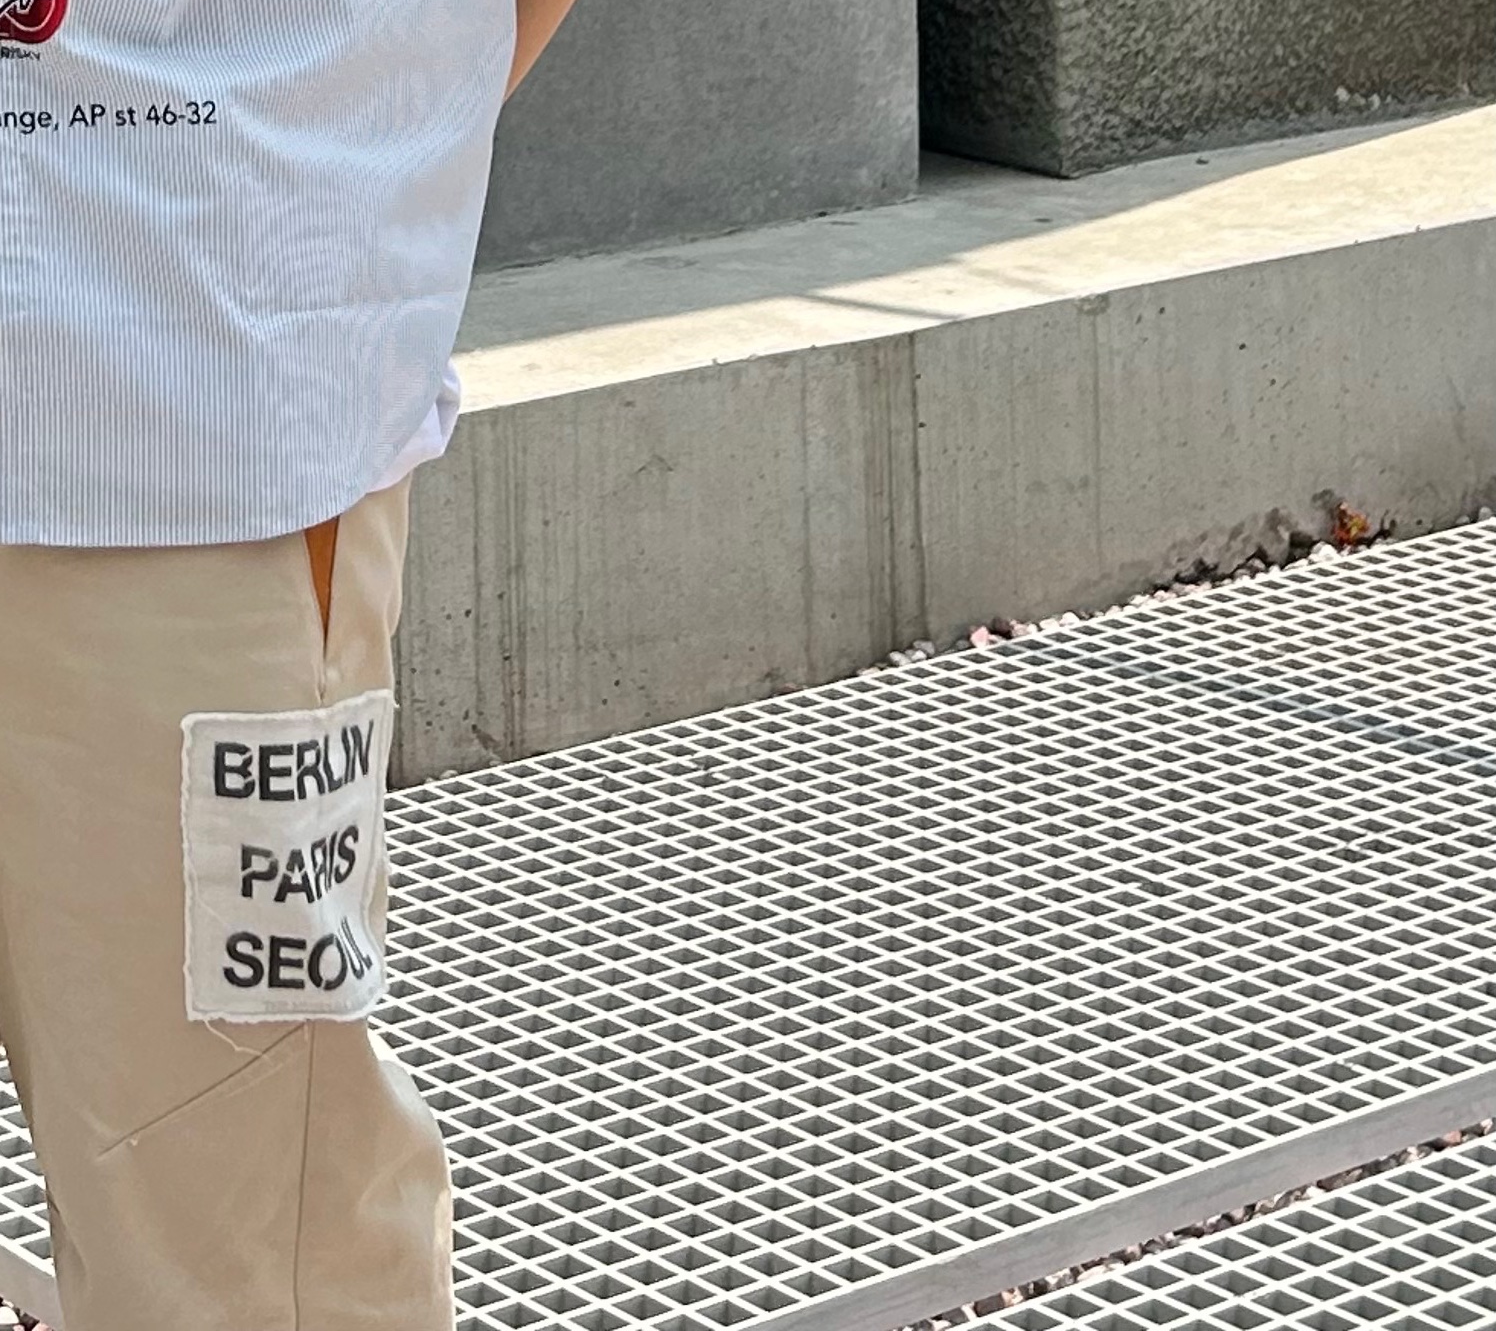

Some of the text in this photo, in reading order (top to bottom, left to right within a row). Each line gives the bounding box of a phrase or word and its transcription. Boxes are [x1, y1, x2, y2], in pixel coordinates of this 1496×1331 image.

[69, 103, 107, 127] AP
[115, 106, 137, 127] st
[146, 100, 217, 127] 46-32
[213, 719, 375, 802] BERLIN
[240, 824, 360, 904] PARIS
[223, 915, 374, 991] SEOUL
